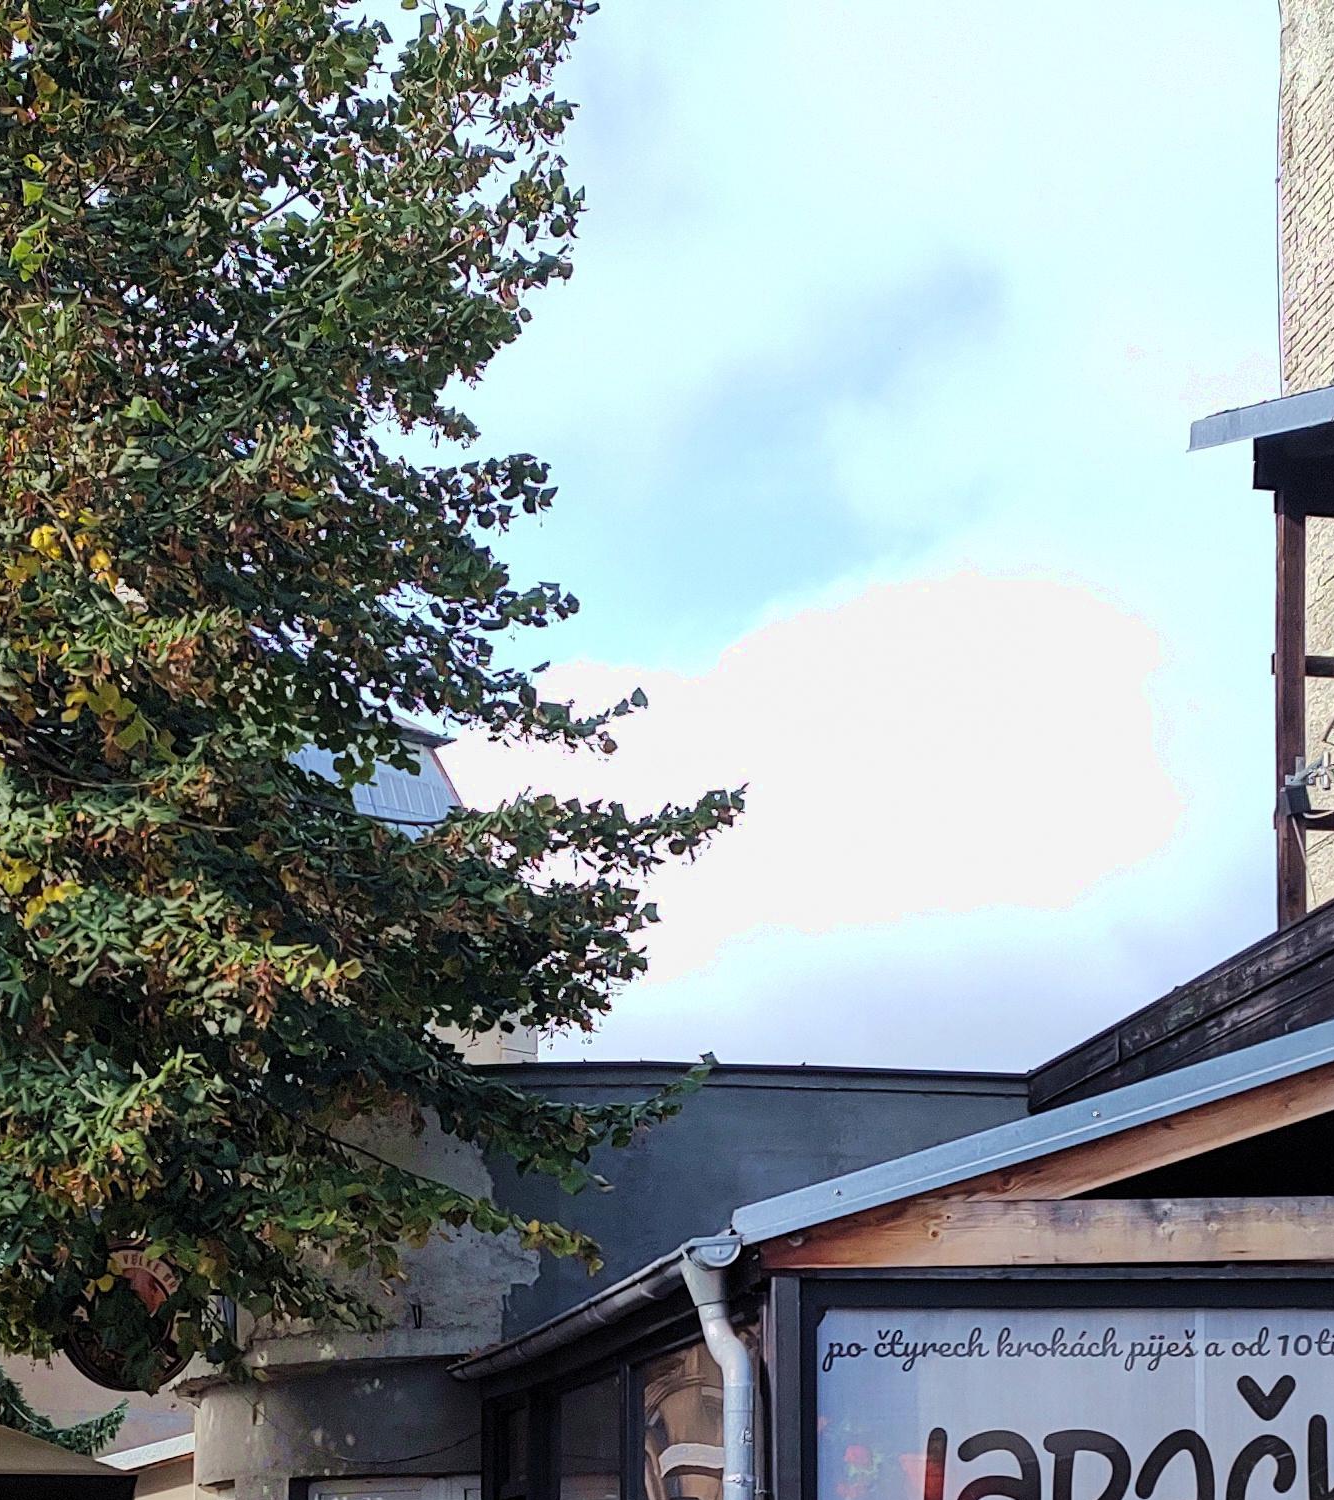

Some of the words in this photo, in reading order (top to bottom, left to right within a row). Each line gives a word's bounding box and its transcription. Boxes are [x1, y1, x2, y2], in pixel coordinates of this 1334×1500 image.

[822, 1342, 866, 1372] po
[874, 1328, 990, 1372] čtyrech
[997, 1327, 1123, 1358] krokách
[1204, 1343, 1225, 1357] a
[1231, 1327, 1270, 1357] od
